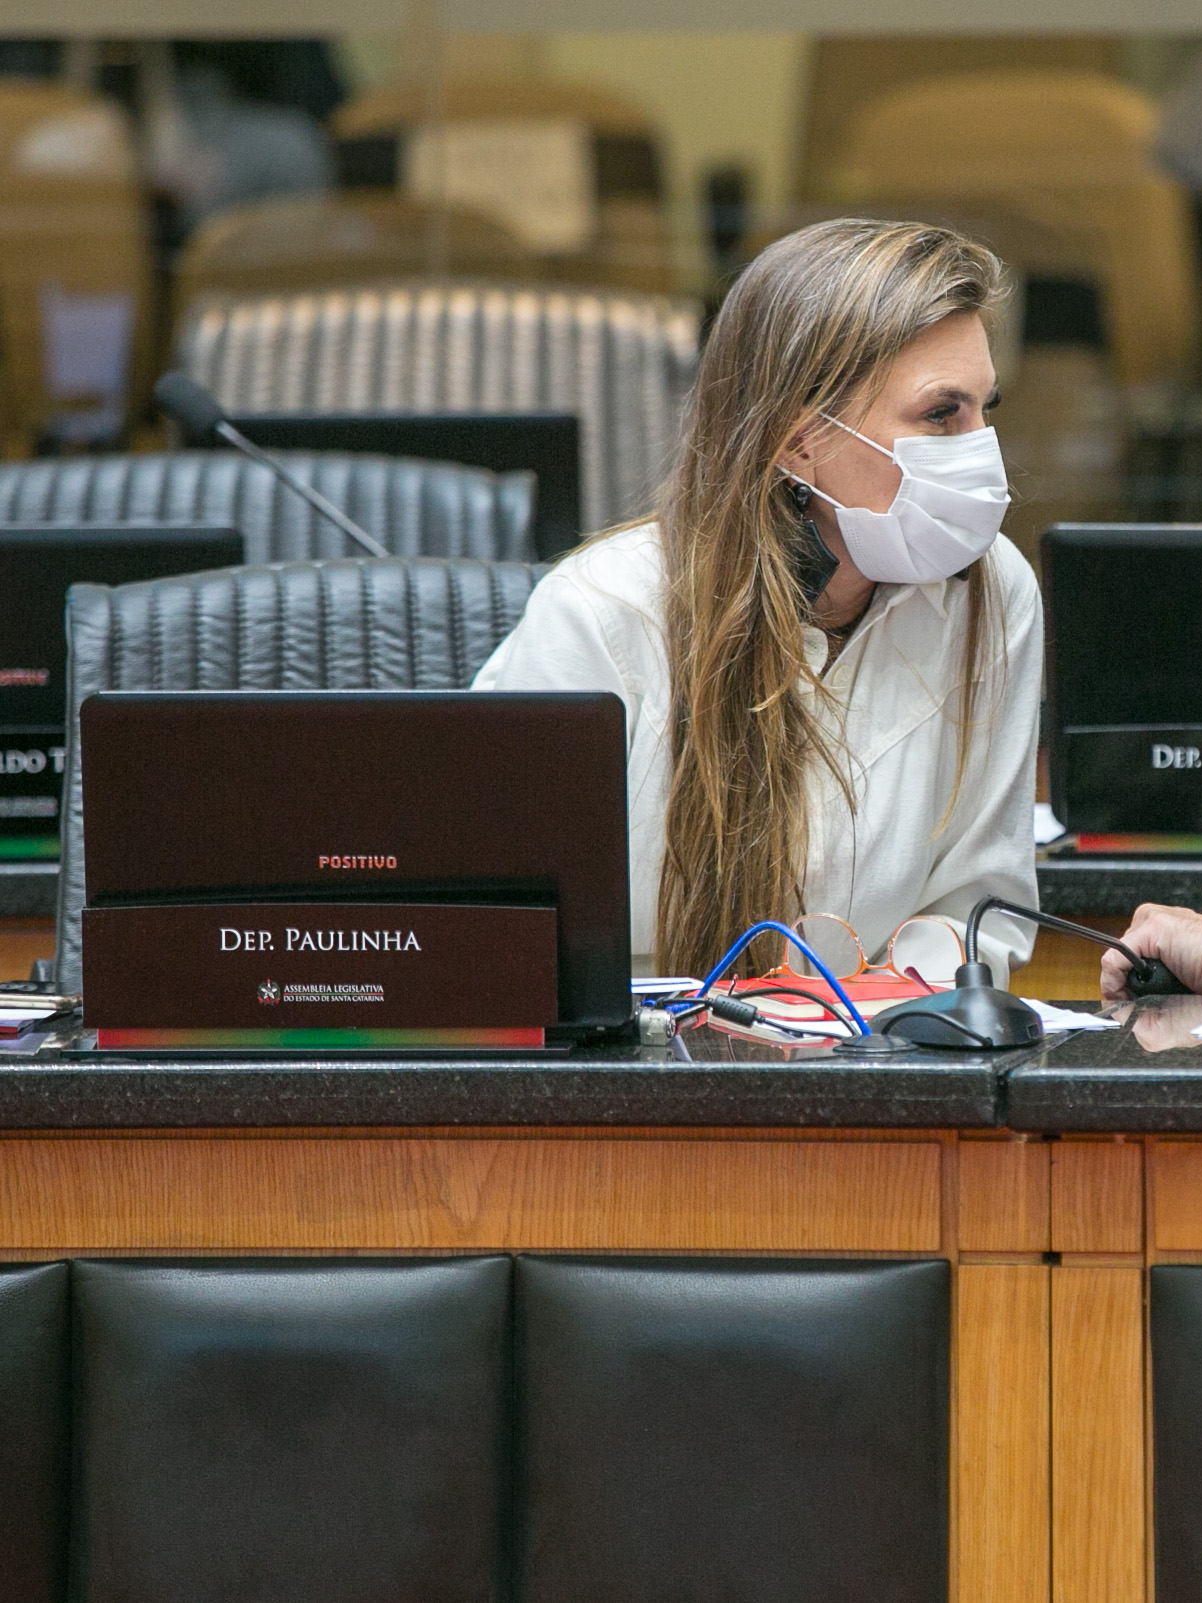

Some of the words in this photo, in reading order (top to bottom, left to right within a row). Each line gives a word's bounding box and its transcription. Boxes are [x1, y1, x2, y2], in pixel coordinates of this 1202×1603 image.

[318, 855, 398, 869] POSITIVO
[219, 927, 274, 951] DEP.
[285, 927, 422, 951] PAULINHA
[284, 984, 332, 993] ASSEMBLEIA
[334, 984, 384, 993] LEGISLATIVA
